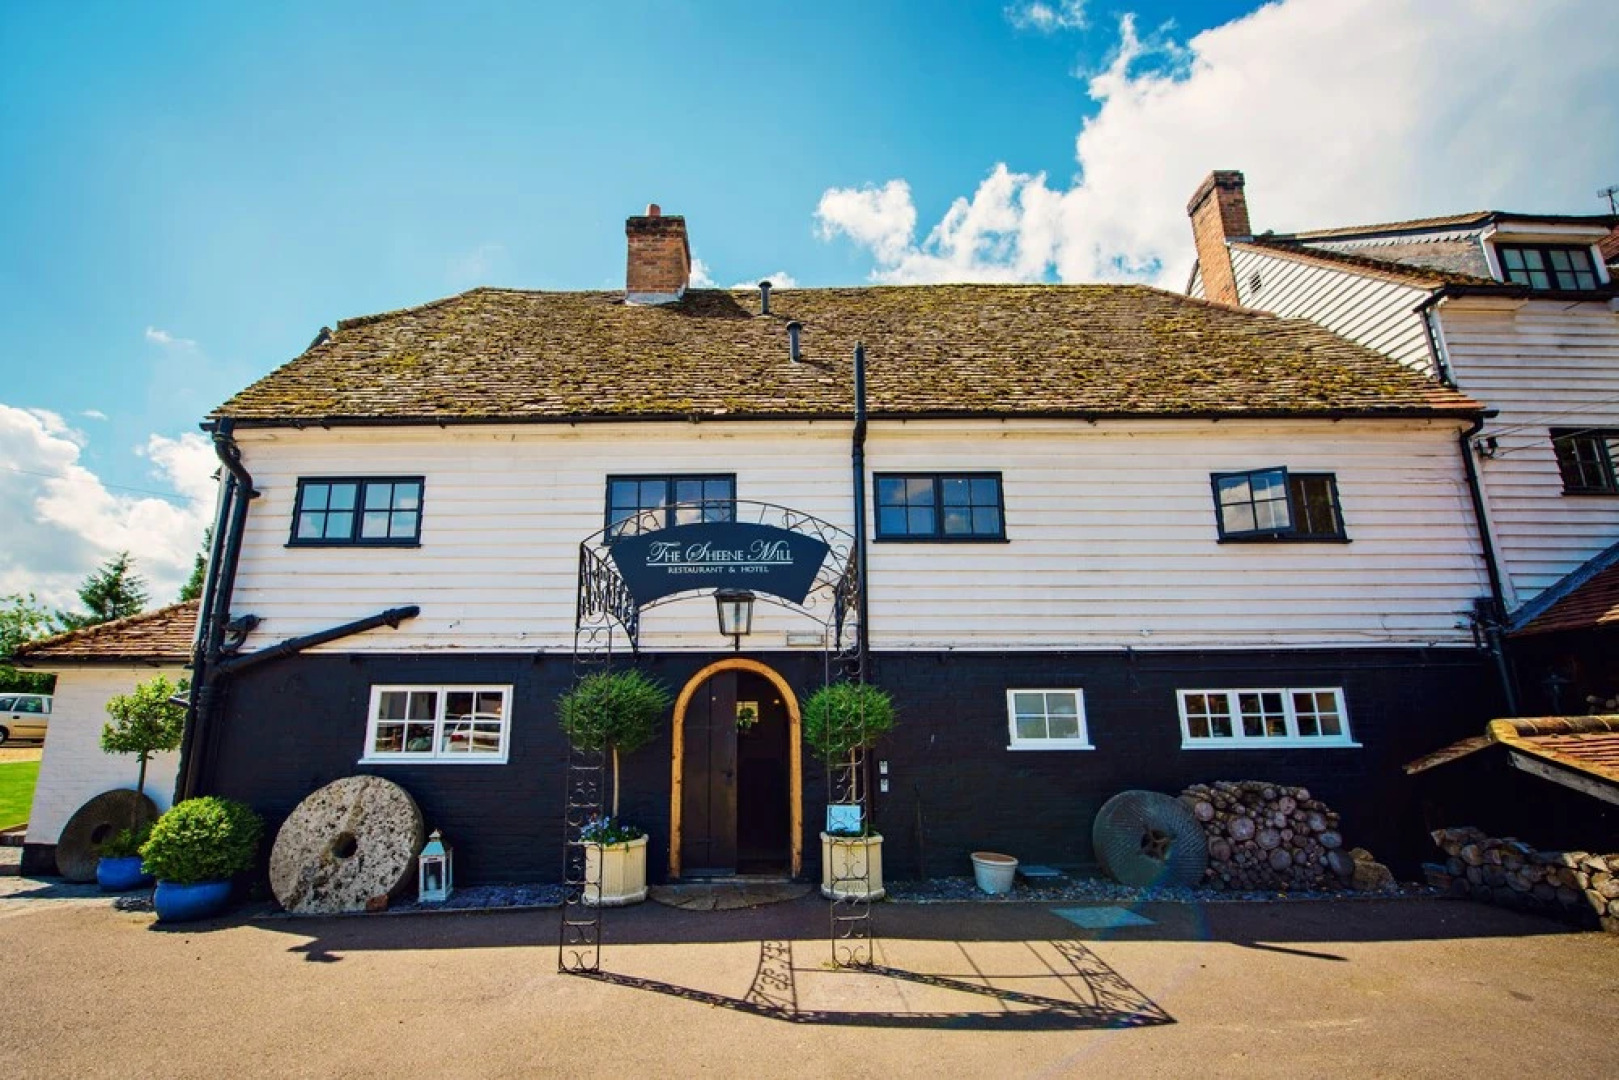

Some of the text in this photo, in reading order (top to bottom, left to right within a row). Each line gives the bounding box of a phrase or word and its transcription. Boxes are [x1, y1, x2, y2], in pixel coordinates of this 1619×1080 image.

[668, 566, 770, 574] RESTAURANT & HOTEL
